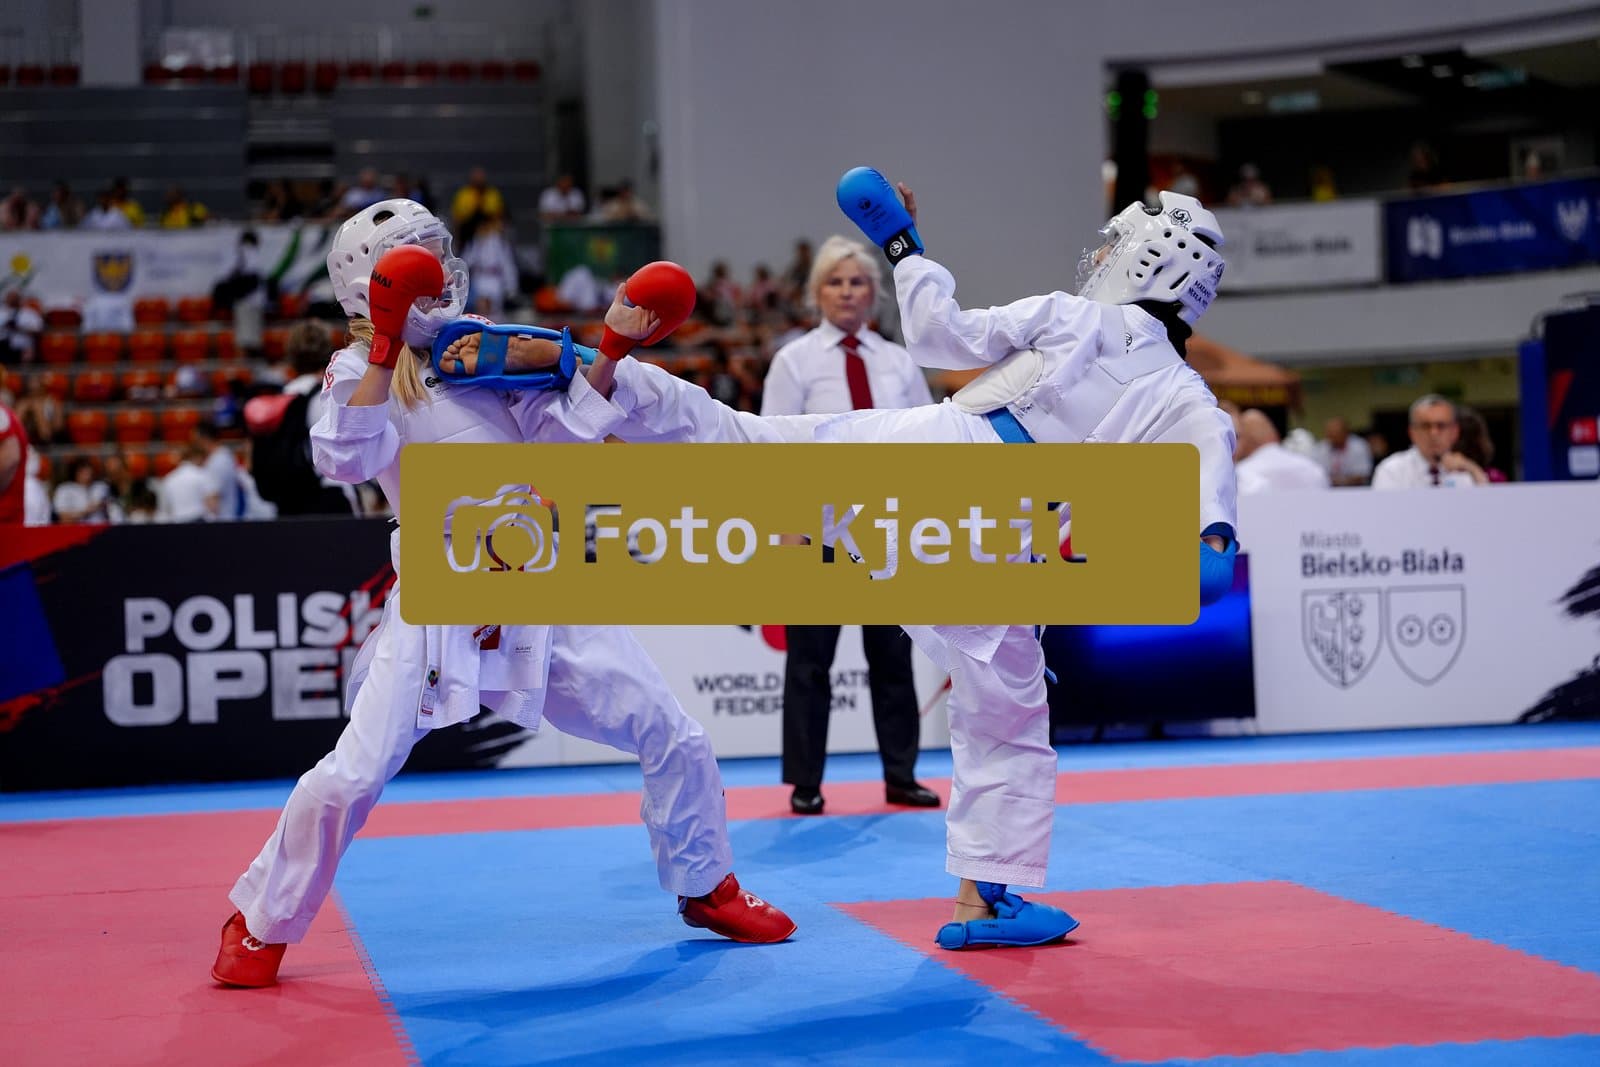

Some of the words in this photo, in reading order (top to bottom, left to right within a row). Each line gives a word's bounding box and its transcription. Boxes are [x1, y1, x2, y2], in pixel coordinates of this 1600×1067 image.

[1301, 548, 1465, 577] Bielsko-Biała
[102, 647, 361, 727] OPE
[694, 673, 781, 694] WORLD
[713, 694, 857, 717] FEDERON
